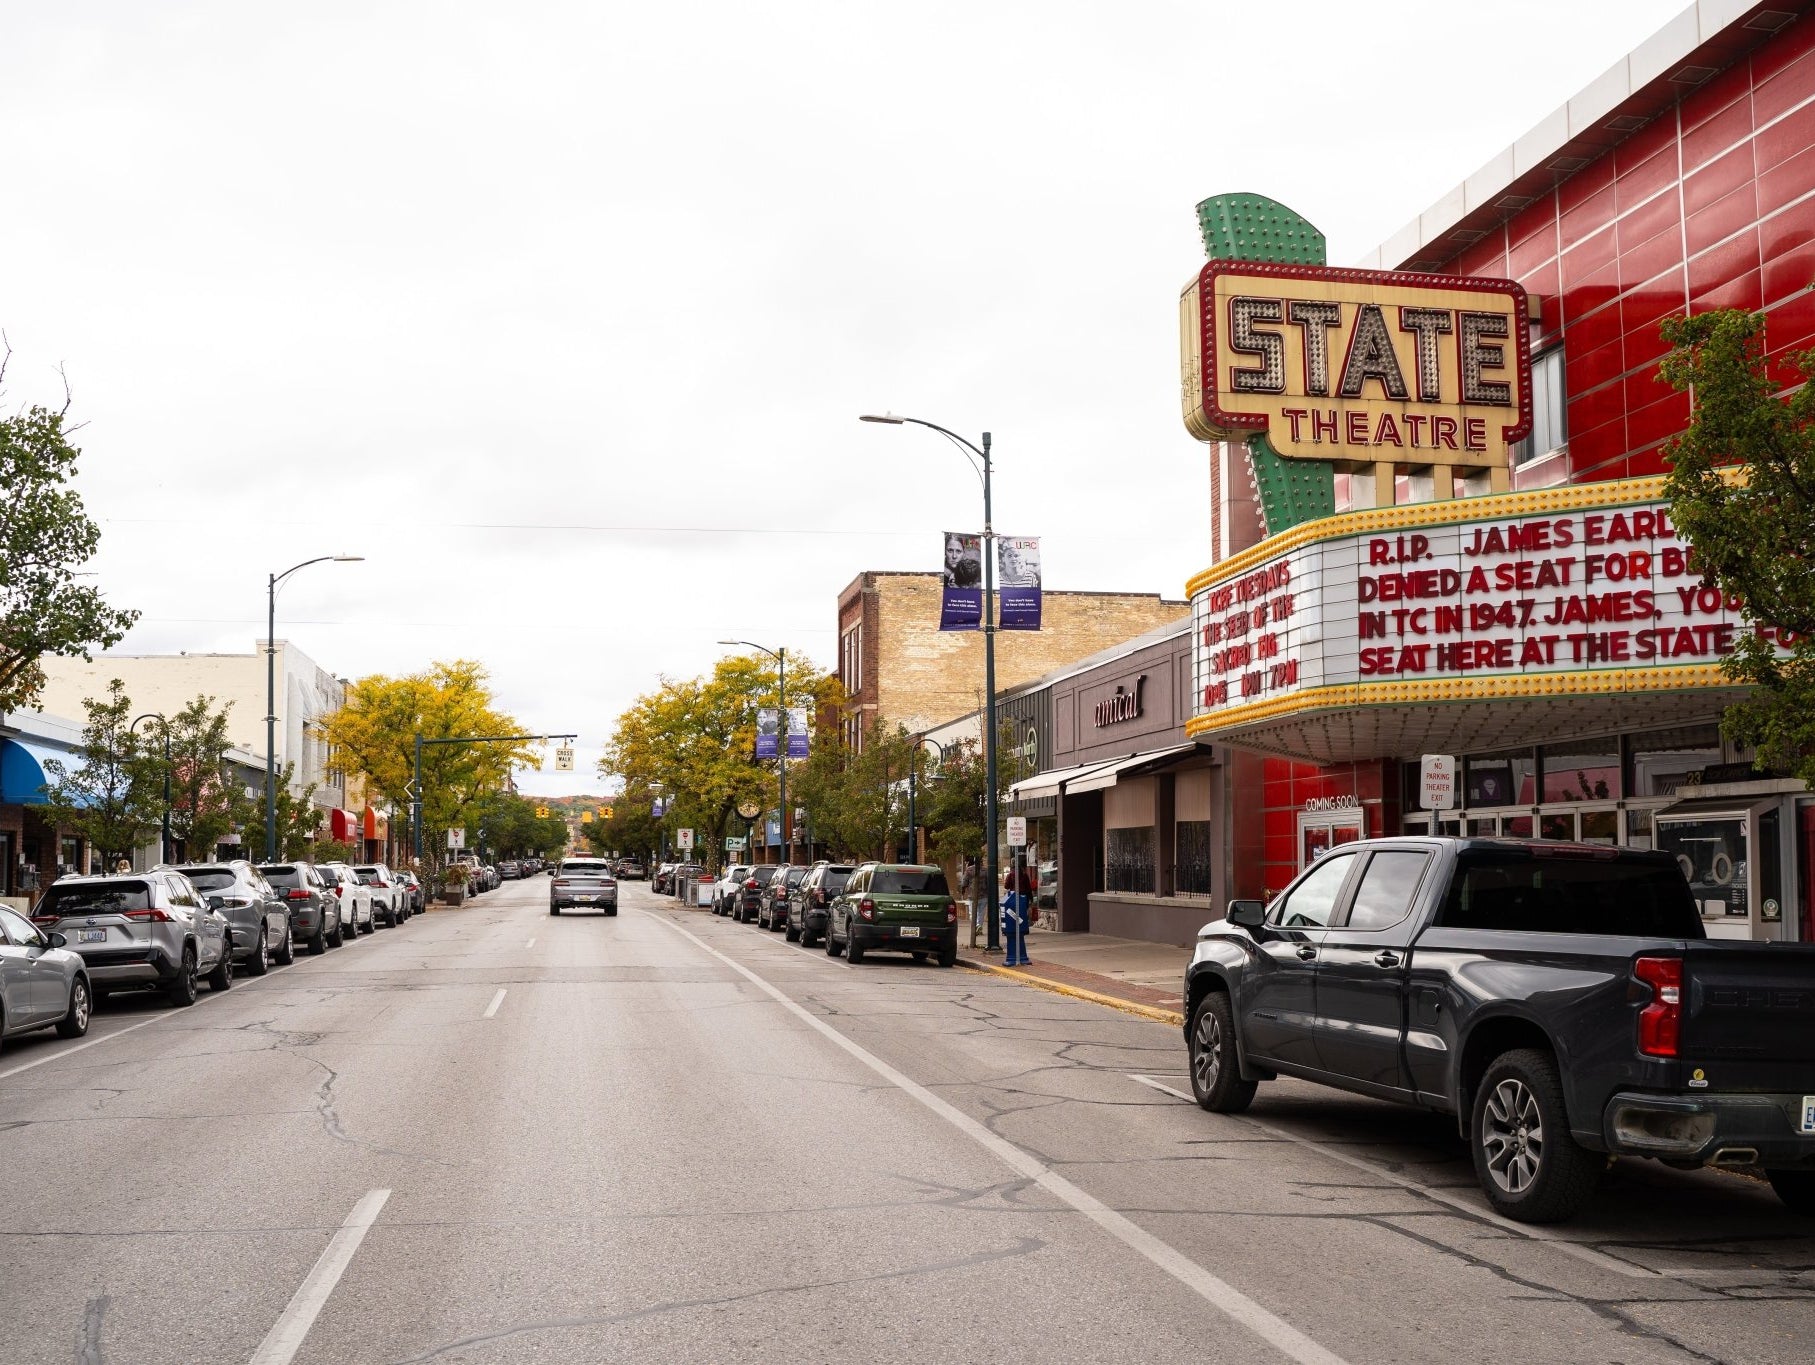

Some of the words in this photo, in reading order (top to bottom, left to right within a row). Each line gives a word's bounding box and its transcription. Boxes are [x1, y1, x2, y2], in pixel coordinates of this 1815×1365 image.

[1228, 296, 1512, 406] STATE
[1281, 407, 1487, 452] THEATRE
[1369, 534, 1433, 566] R.I.P.
[1464, 519, 1574, 556] JAMES
[1584, 509, 1675, 546] EARL
[1234, 559, 1290, 604] TUESDAYS
[1358, 568, 1461, 603] DENIED
[1466, 565, 1490, 594] A
[1495, 557, 1576, 591] SEAT
[1585, 551, 1652, 584] FOR
[1203, 622, 1221, 647] THE
[1220, 610, 1250, 640] SEED
[1253, 602, 1268, 629] OF
[1270, 594, 1294, 622] THE
[1359, 611, 1386, 639] IN
[1392, 607, 1428, 636] TC
[1435, 604, 1463, 634] IN
[1470, 598, 1537, 632] 1947.
[1544, 590, 1662, 625] JAMES,
[1212, 642, 1251, 675] SACRED
[1258, 632, 1277, 660] FIG
[1359, 643, 1430, 675] SEAT
[1437, 638, 1513, 671] HERE
[1519, 634, 1560, 666] AT
[1567, 631, 1630, 663] THE
[1635, 623, 1735, 659] STATE
[1270, 658, 1297, 691] 7PM
[1094, 675, 1148, 728] amical
[1426, 773, 1450, 781] PARKING
[1426, 784, 1450, 792] THEATER
[1434, 762, 1443, 770] NO
[1305, 797, 1335, 811] COMING
[1336, 794, 1359, 810] SOON
